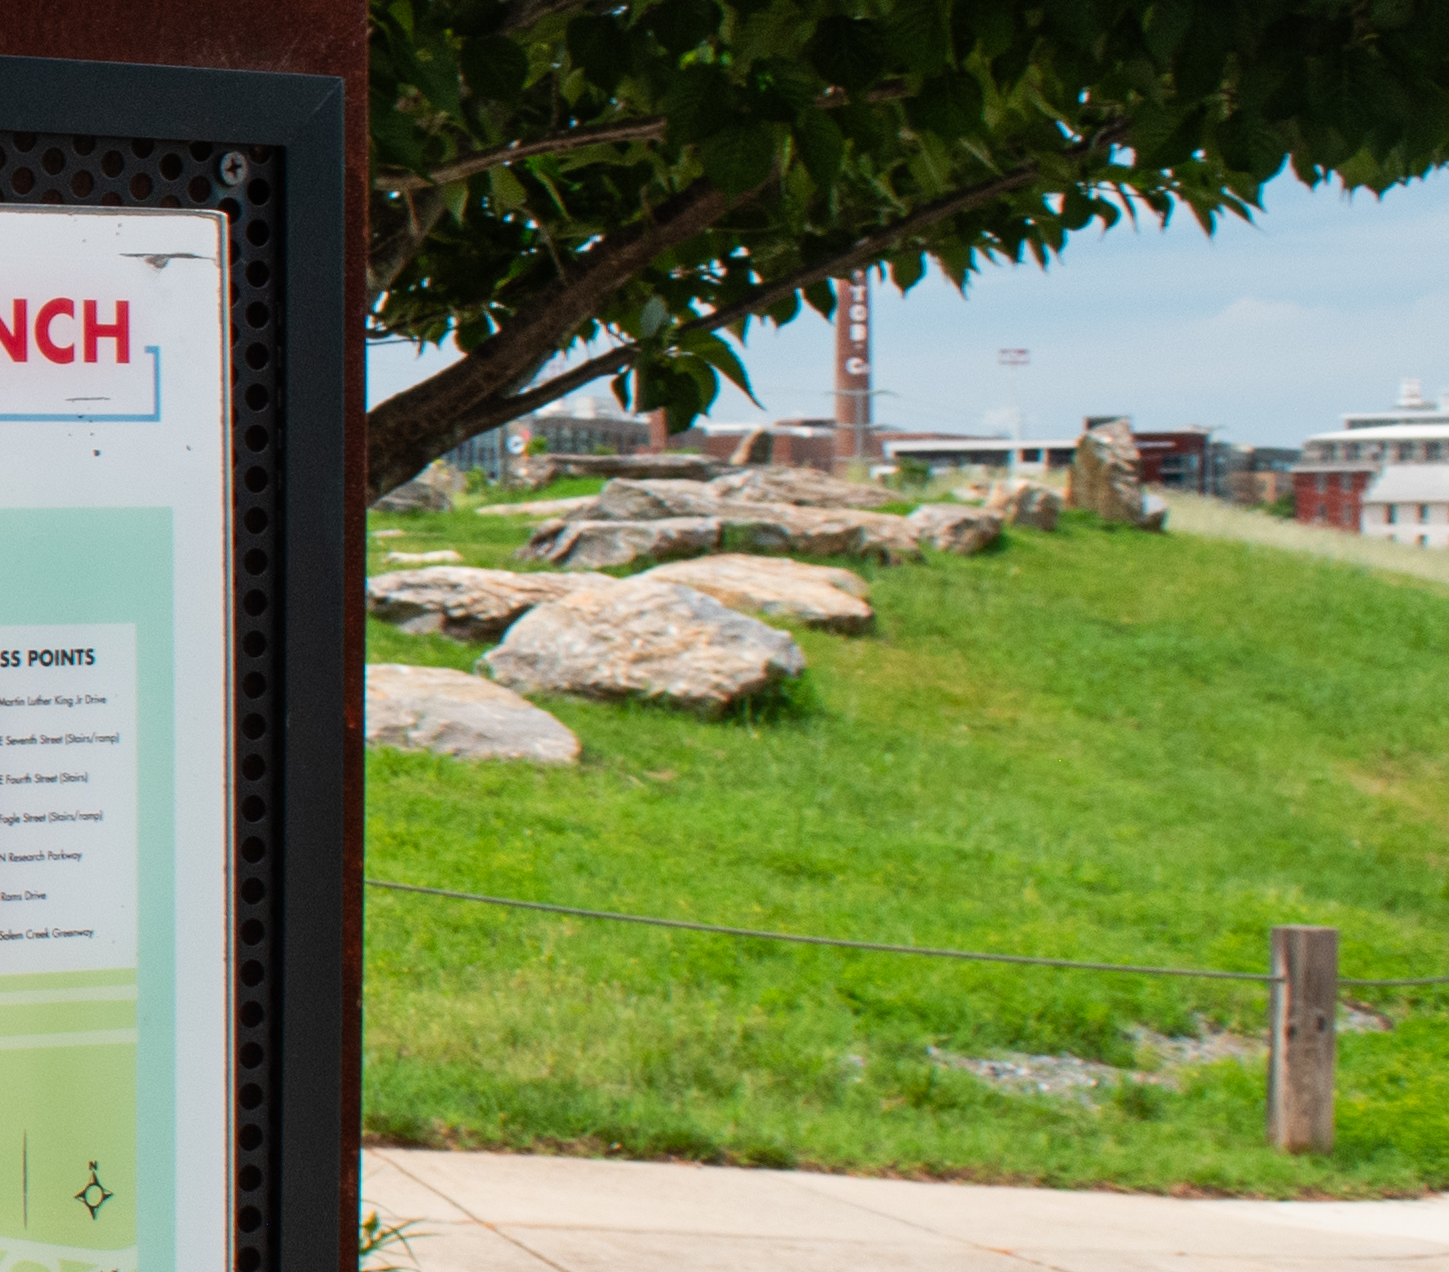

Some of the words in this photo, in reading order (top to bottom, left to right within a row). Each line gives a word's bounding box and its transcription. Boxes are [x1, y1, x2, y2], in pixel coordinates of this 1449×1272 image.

[27, 648, 96, 667] POINTS
[27, 694, 52, 706] Luther
[54, 694, 73, 709] King
[85, 694, 107, 705] Drive
[5, 733, 38, 746] Seventh
[40, 733, 63, 745] Street
[34, 773, 58, 784] Street
[23, 812, 46, 824] Street
[8, 851, 46, 863] Research
[47, 849, 82, 865] Parkway
[24, 889, 47, 902] Drive
[26, 928, 50, 940] Creek
[52, 928, 94, 941] Greenway
[88, 1160, 98, 1171] N
